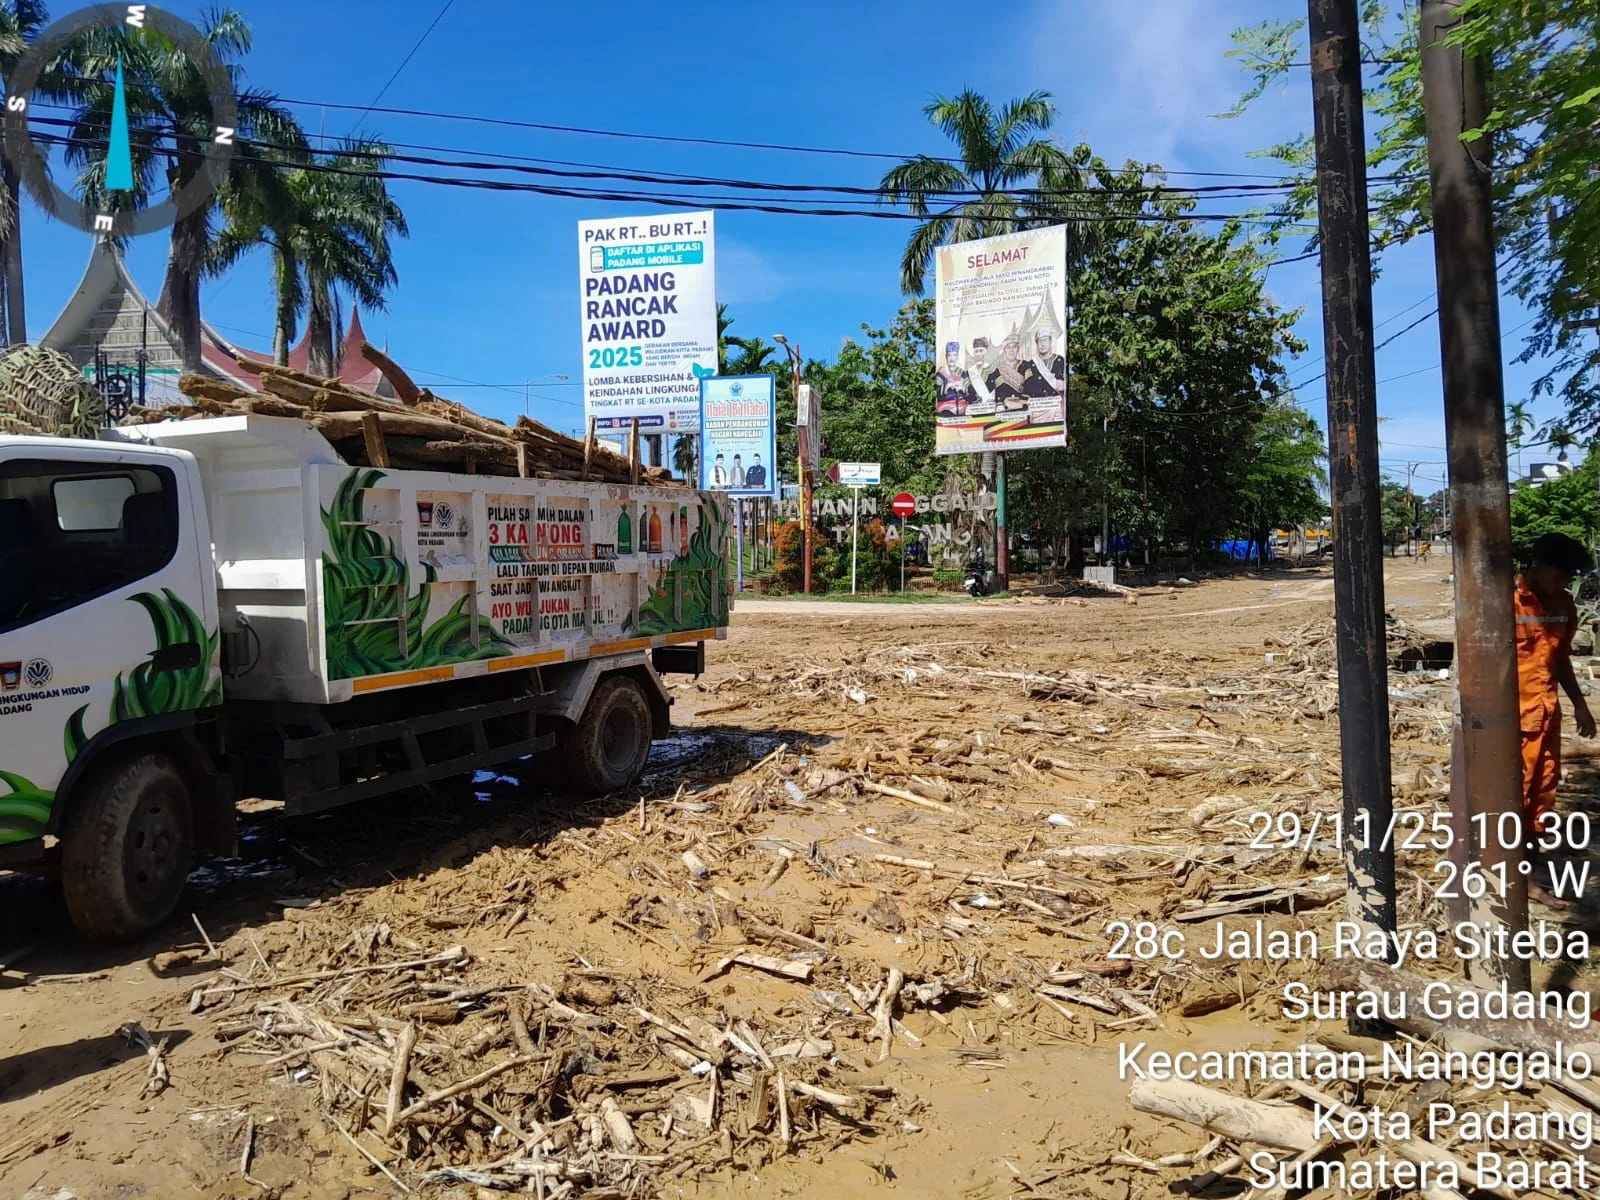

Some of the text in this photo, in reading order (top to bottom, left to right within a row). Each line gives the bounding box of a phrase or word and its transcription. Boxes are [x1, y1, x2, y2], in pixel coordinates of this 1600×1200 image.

[585, 220, 707, 243] PAK RT.. BU RT..!
[607, 244, 644, 257] DAFTAR
[645, 244, 656, 254] DI
[657, 242, 701, 253] APLIKASI
[967, 246, 1030, 269] SELAMAT
[607, 254, 683, 268] PADANG MOBILE
[586, 272, 676, 297] PADANG
[586, 295, 678, 319] RANCAK
[587, 319, 666, 342] AWARD
[589, 346, 643, 369] 2025
[589, 372, 694, 387] LOMBA KEBERSIHAN &
[589, 386, 643, 398] KEINDAHAN
[590, 395, 699, 408] TINGKAT RT SE-KOTA PADAN
[488, 507, 516, 522] PILAH
[489, 523, 499, 544] 3
[496, 561, 616, 578] LALU TARUH DI DEPAN RUMAH
[491, 583, 513, 597] SAAT
[551, 579, 581, 593] ANGKUT
[491, 603, 512, 619] AYO
[0, 685, 91, 705] INGKUNGAN HIDUP
